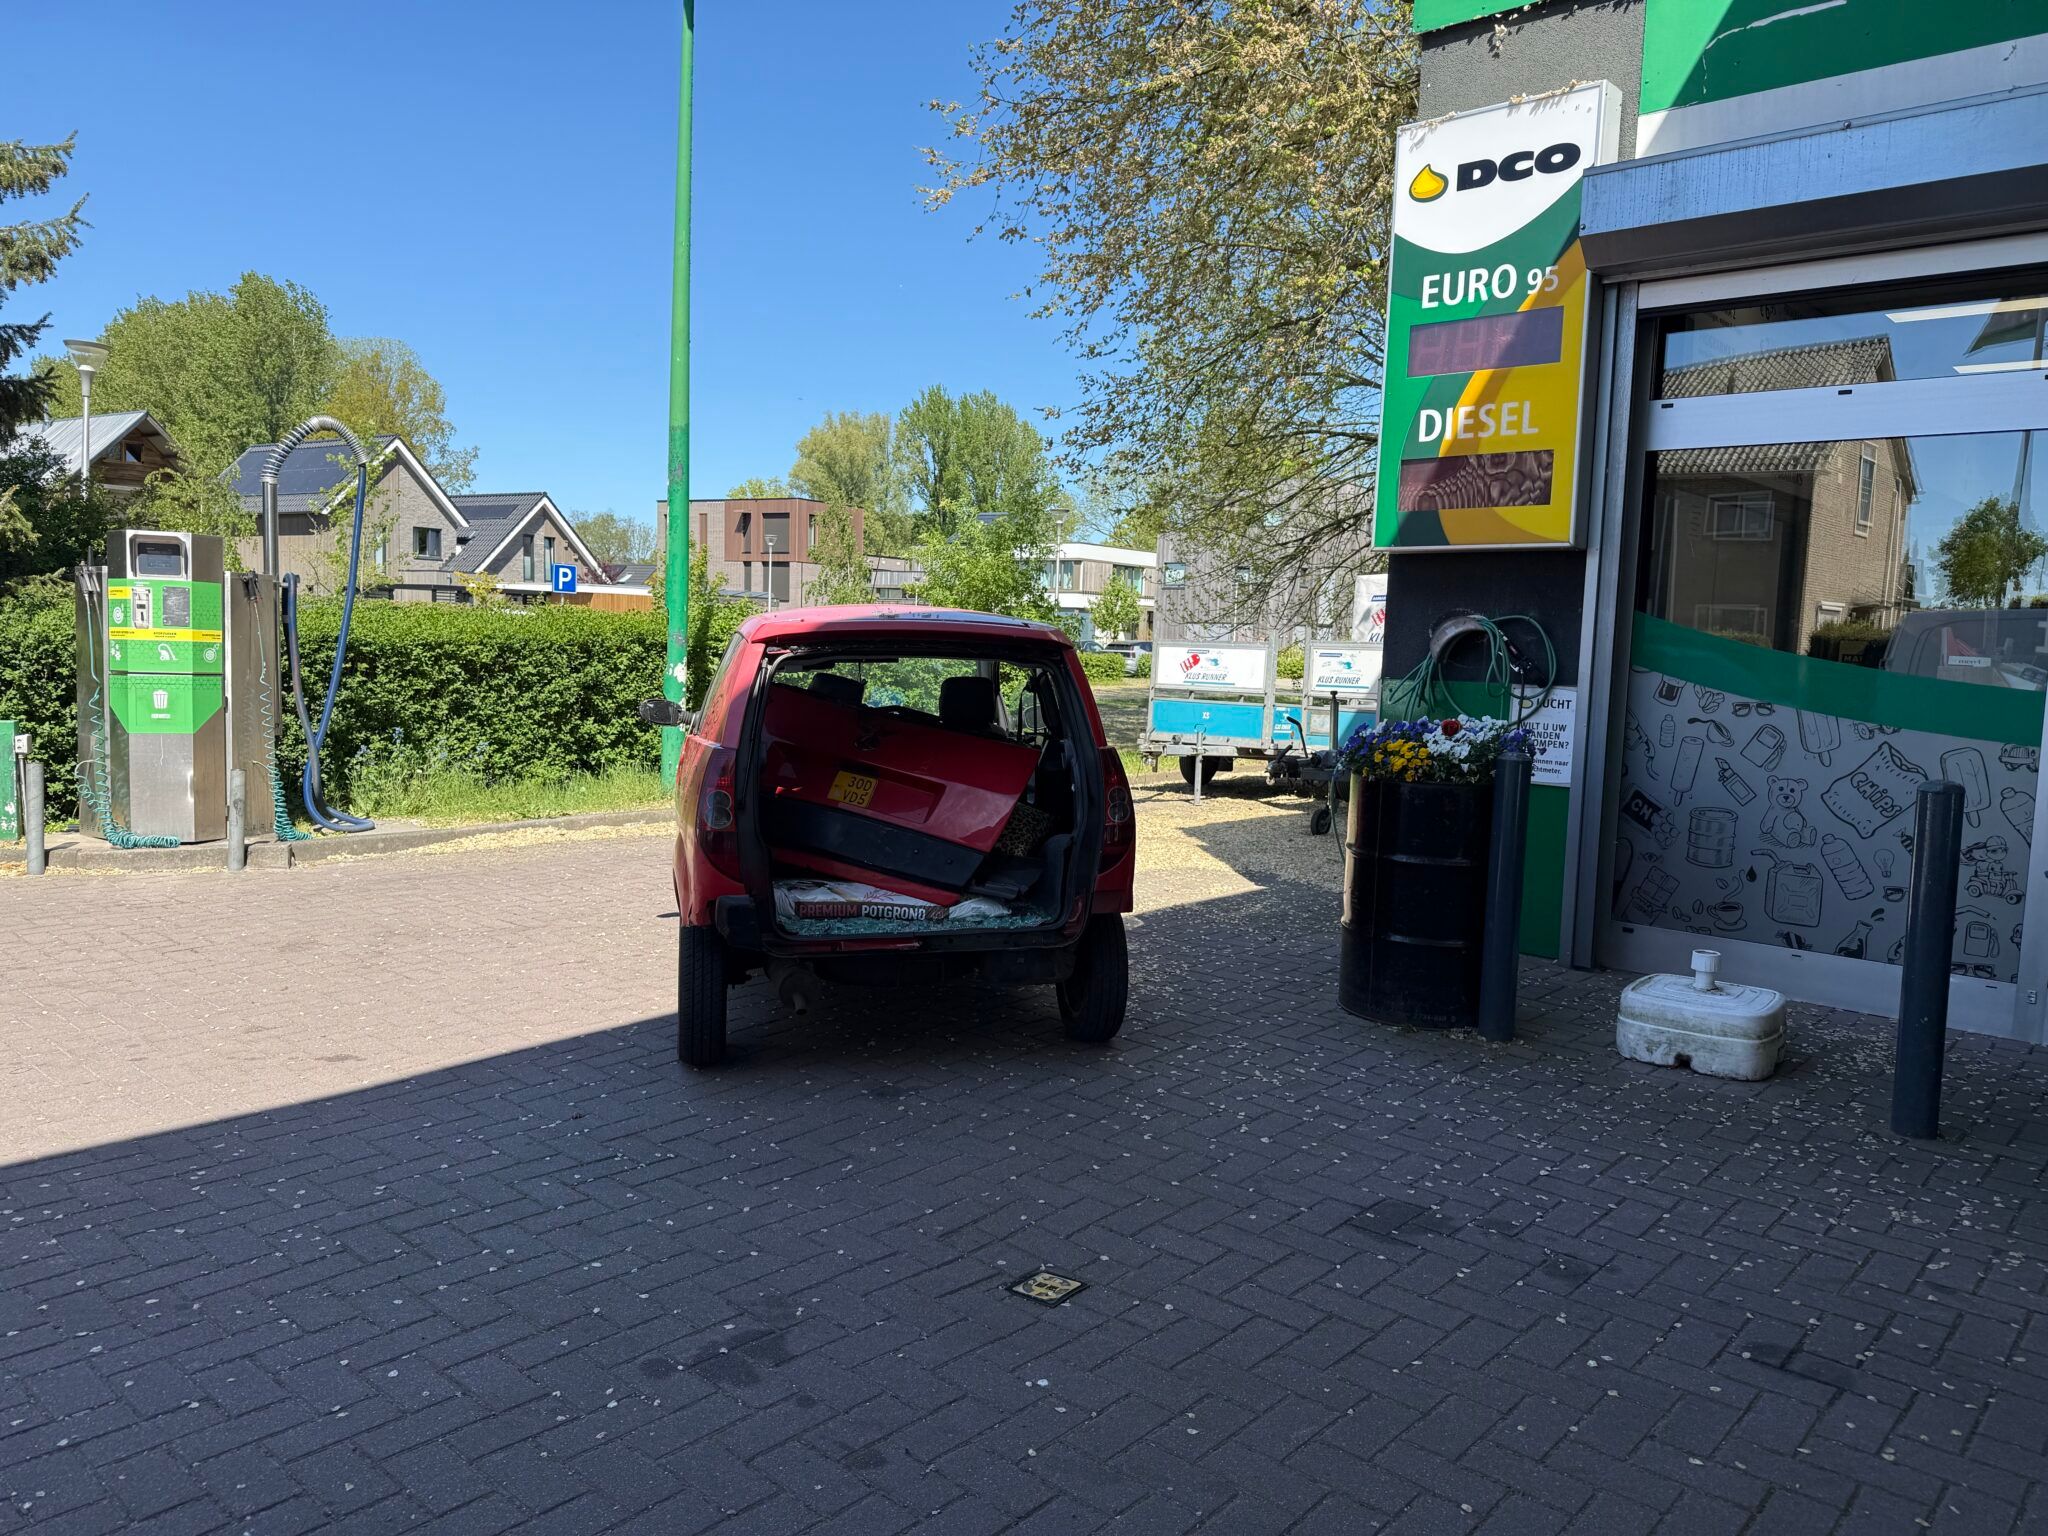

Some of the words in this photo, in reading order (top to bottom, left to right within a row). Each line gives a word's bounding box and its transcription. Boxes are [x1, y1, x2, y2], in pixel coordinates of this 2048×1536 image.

[1456, 142, 1582, 192] DCO
[1421, 263, 1518, 309] EURO
[1526, 264, 1560, 296] 95
[1418, 400, 1540, 443] DIESEL
[559, 567, 572, 590] P
[1184, 671, 1201, 681] KLUS
[1201, 672, 1228, 682] RUNNER
[1317, 675, 1334, 684] KLUS
[1334, 676, 1361, 685] RUNNER
[1542, 722, 1549, 732] U
[1552, 723, 1567, 733] UW
[1532, 739, 1570, 750] OMPEN?
[800, 903, 858, 918] PREMIUM
